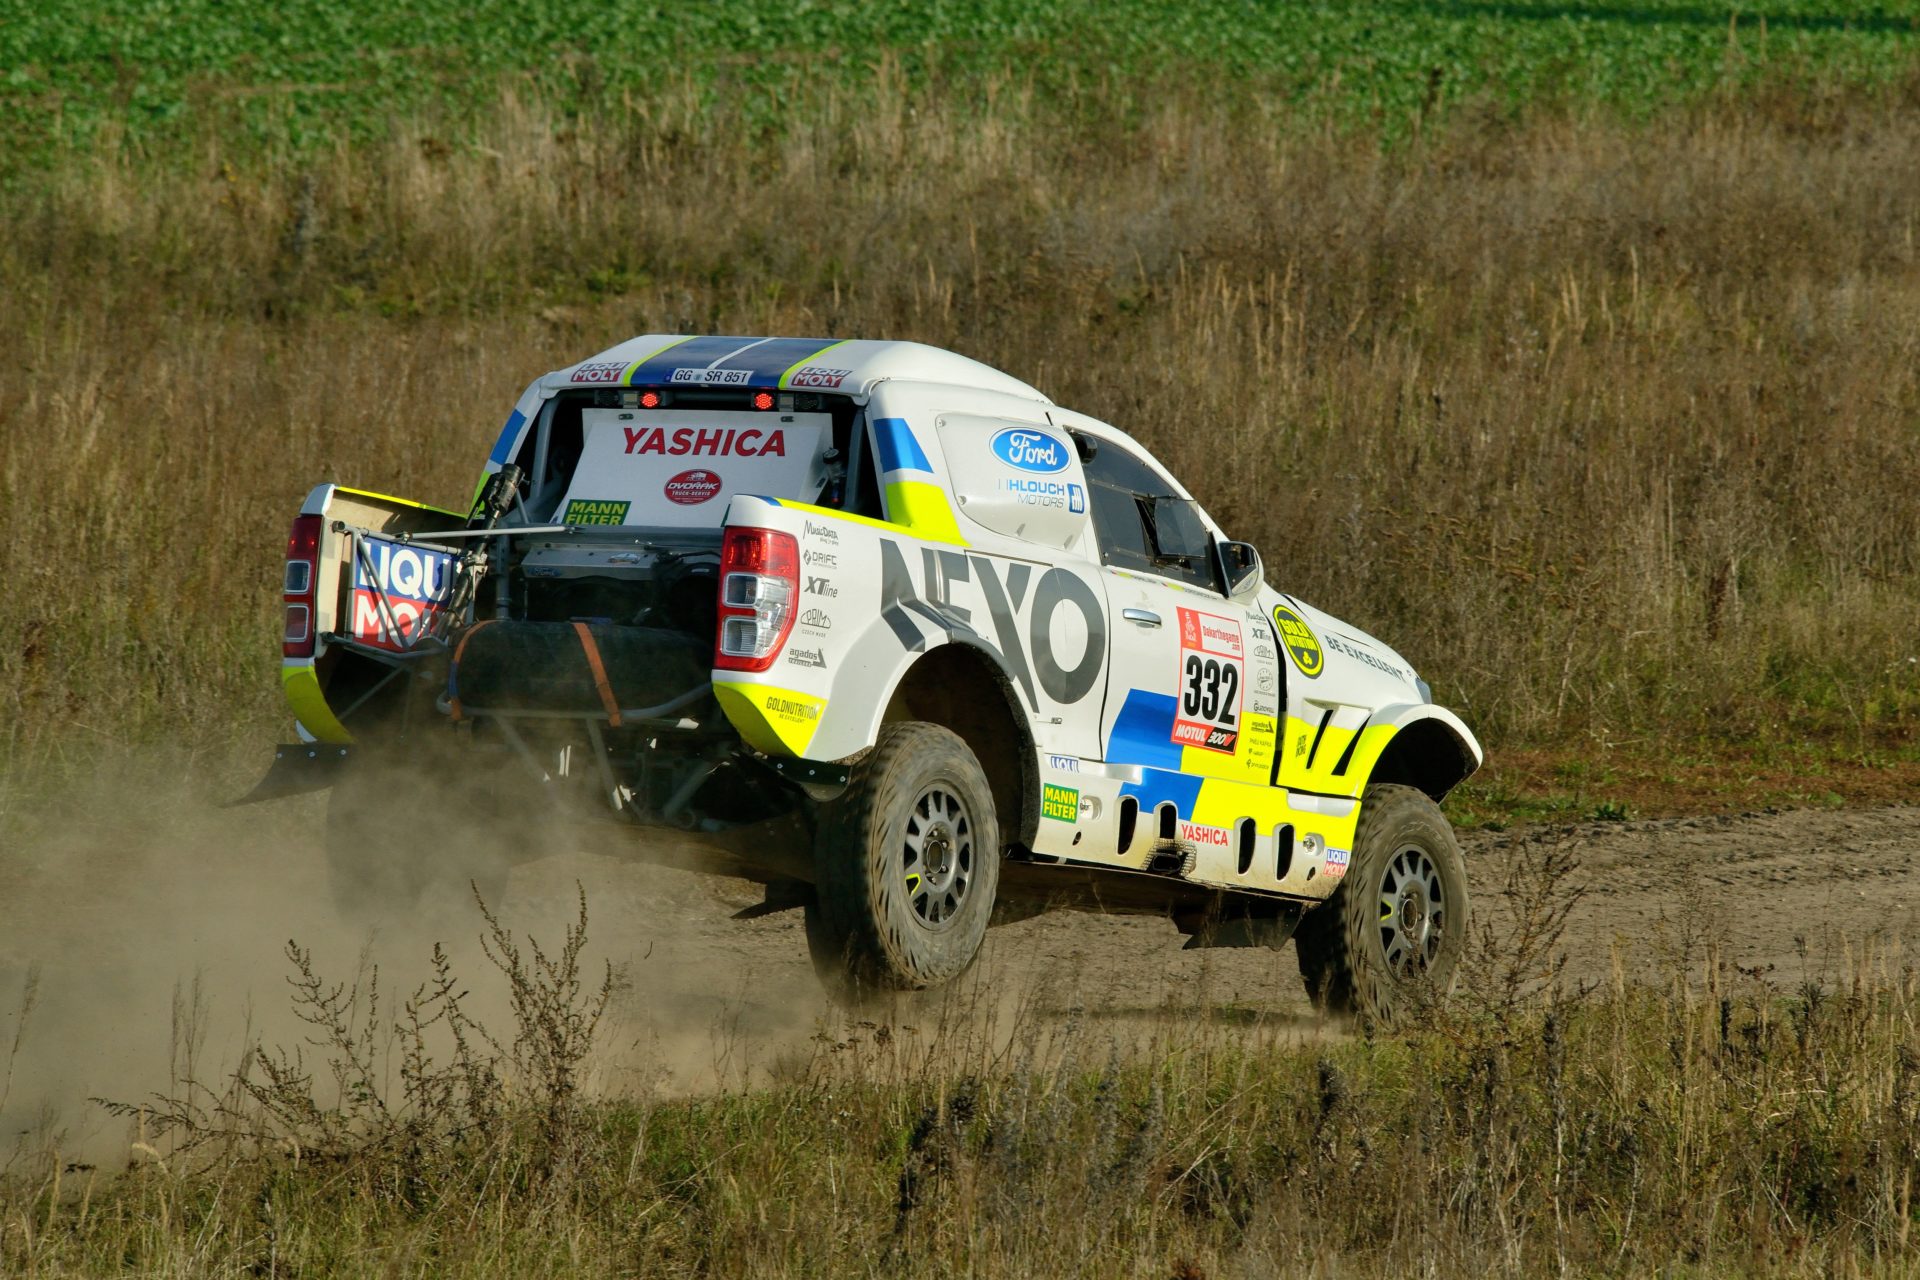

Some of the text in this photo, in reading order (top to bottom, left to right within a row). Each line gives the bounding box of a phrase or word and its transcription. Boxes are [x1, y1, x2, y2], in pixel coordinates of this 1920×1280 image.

[573, 370, 620, 381] MOLY
[674, 369, 747, 383] GG SR 851
[794, 374, 841, 387] MOLY
[623, 427, 786, 457] YASHICA
[1008, 432, 1058, 466] Ford
[569, 501, 626, 515] MANN
[1018, 494, 1065, 509] MOTORS
[565, 514, 622, 525] FILTER
[359, 542, 458, 601] LIQU
[789, 648, 818, 660] agados
[1325, 635, 1403, 681] BE EXCELLENT
[1183, 654, 1239, 726] 332
[766, 695, 818, 721] GOLDNUTRITION
[1175, 724, 1236, 747] MOTUL 300V
[1044, 786, 1077, 806] MANN
[1043, 801, 1076, 820] FILTER
[1181, 823, 1229, 847] YASHICA
[1327, 850, 1347, 864] LIQUI
[1324, 861, 1345, 876] MOLY
